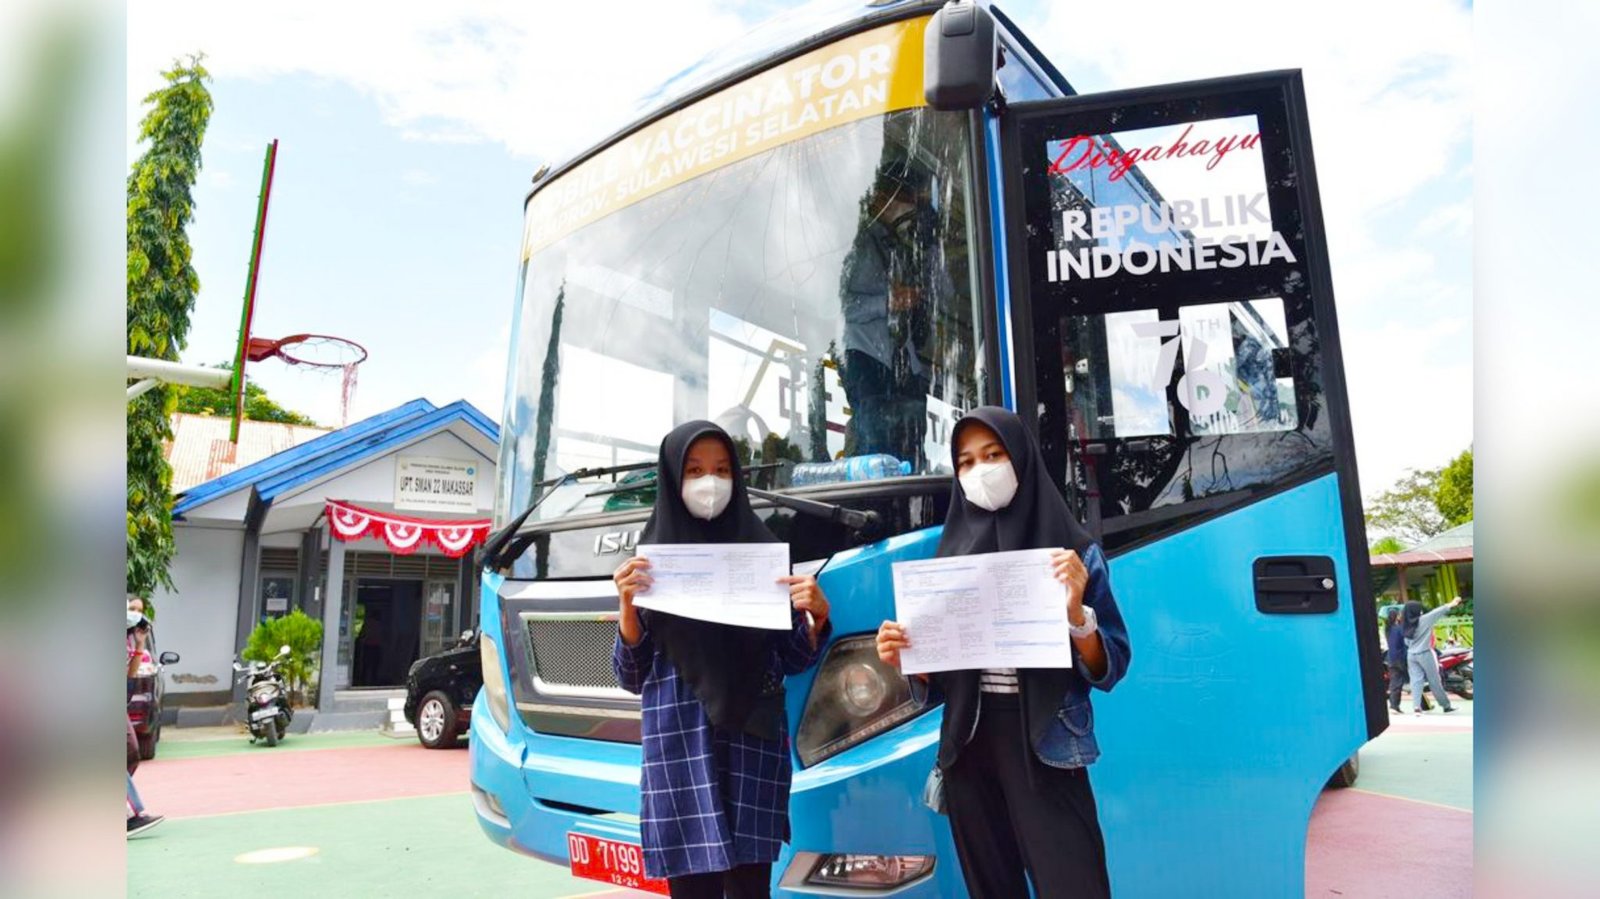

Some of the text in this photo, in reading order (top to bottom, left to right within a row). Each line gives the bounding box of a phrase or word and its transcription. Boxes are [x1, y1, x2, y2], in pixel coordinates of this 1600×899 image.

[630, 44, 892, 166] VACCINATOR
[616, 134, 738, 202] SULAWESI
[745, 80, 887, 146] SELATAN
[1046, 124, 1262, 182] Dirgahayu
[1061, 192, 1272, 242] REPUBLIK
[1046, 230, 1298, 283] INDONESIA
[415, 477, 432, 493] SMAN
[433, 478, 440, 494] 22
[441, 479, 473, 496] MAKASSAR
[594, 530, 640, 556] ISU
[569, 835, 640, 875] DD 7199
